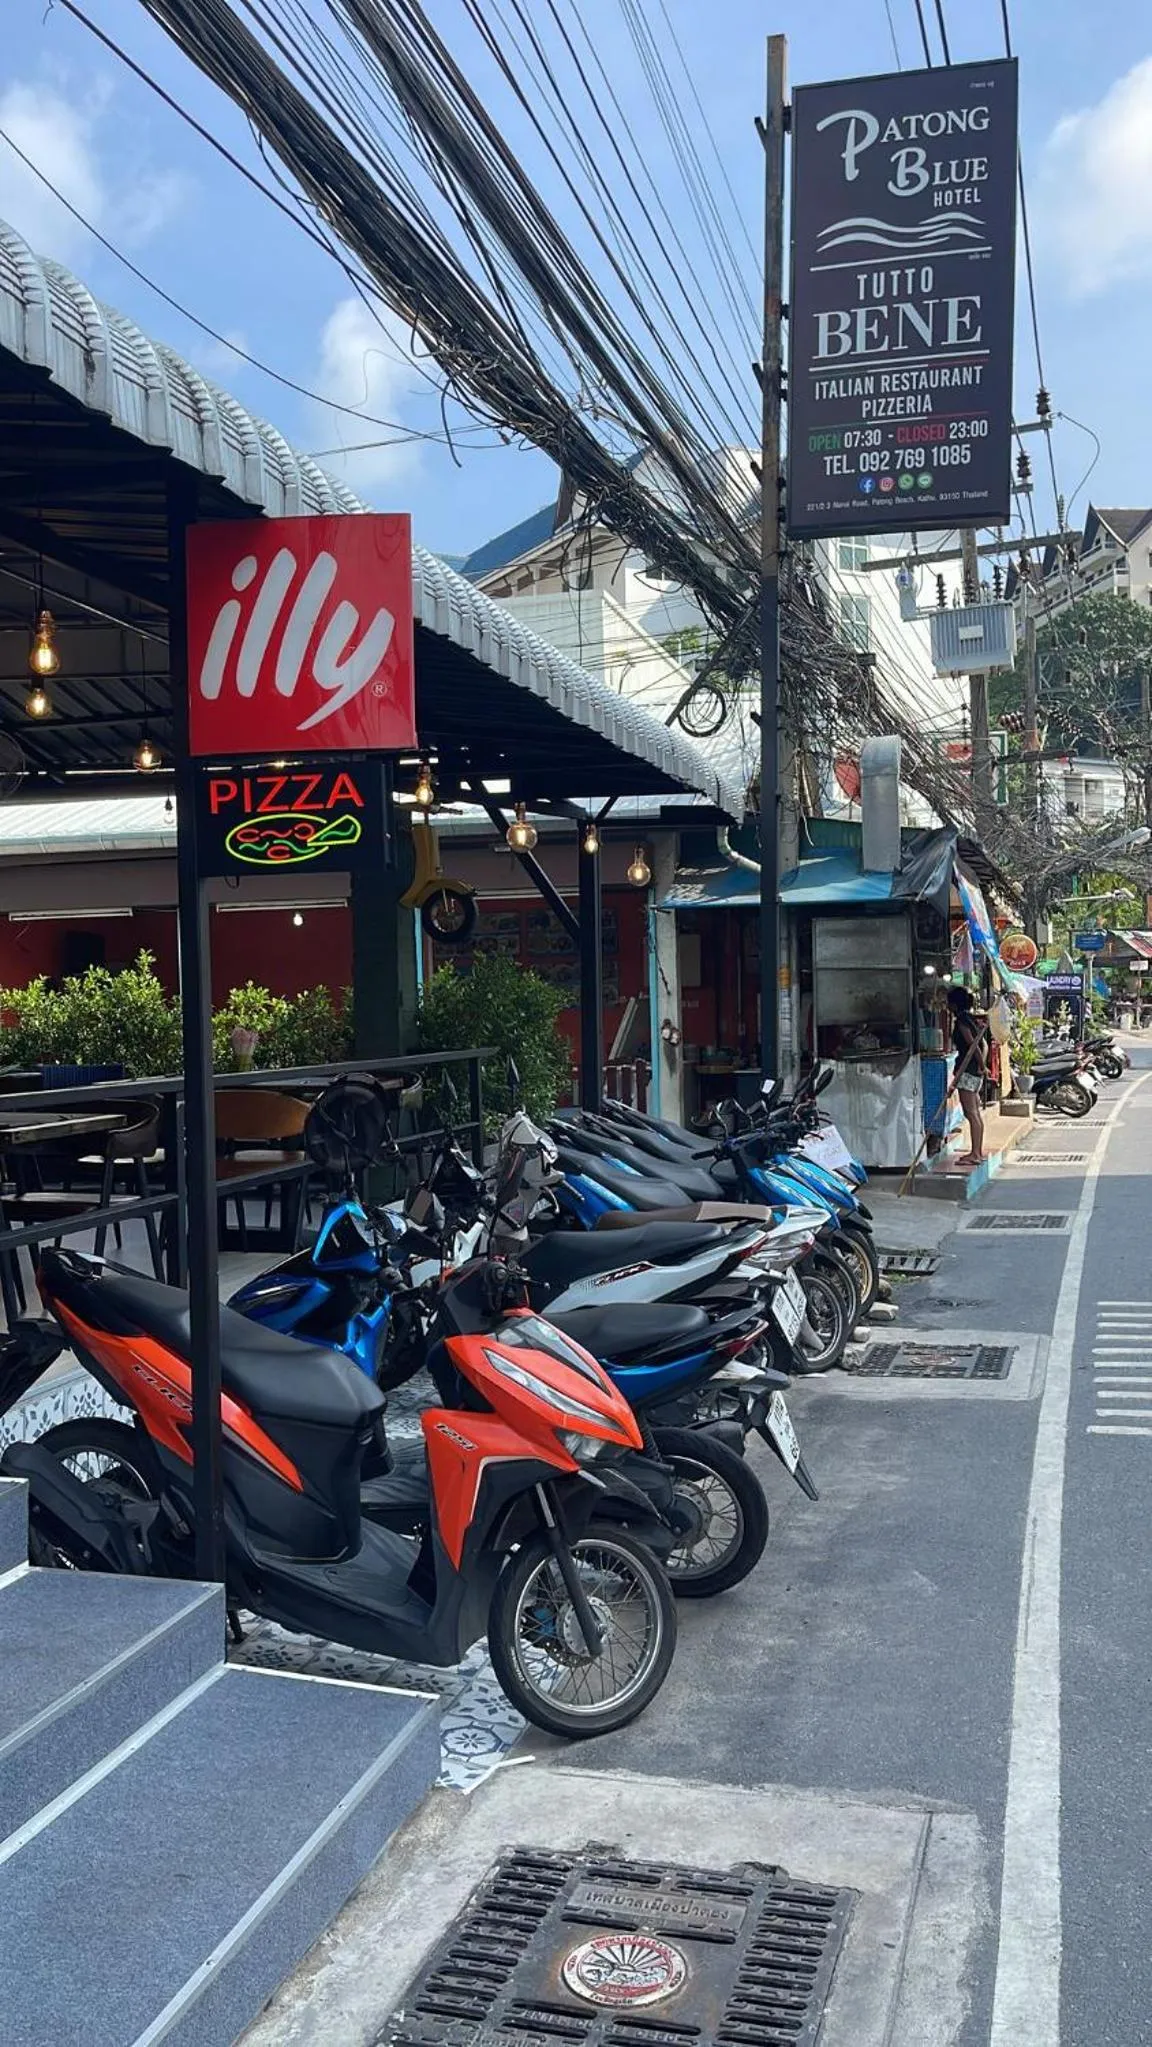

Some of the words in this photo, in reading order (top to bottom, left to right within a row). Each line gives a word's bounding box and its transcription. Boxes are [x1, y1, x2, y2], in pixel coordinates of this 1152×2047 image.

[816, 106, 991, 182] PATONG
[887, 147, 989, 196] BLUE
[933, 188, 982, 208] HOTEL
[856, 266, 933, 301] TUTTO
[812, 295, 982, 360] BENE
[815, 376, 875, 401] ITALIAN
[880, 365, 983, 394] RESTAURANT
[861, 394, 933, 419] PIZZERIA
[808, 433, 842, 453] OPEN
[844, 429, 882, 449] 07:30
[895, 423, 946, 444] CLOSED
[949, 420, 988, 439] 23:00
[823, 455, 856, 476] TEL.
[859, 450, 890, 473] 092
[895, 446, 925, 470] 769
[931, 443, 971, 467] 1085
[962, 489, 988, 499] Thailand
[200, 547, 396, 731] illy
[209, 772, 365, 815] PIZZA
